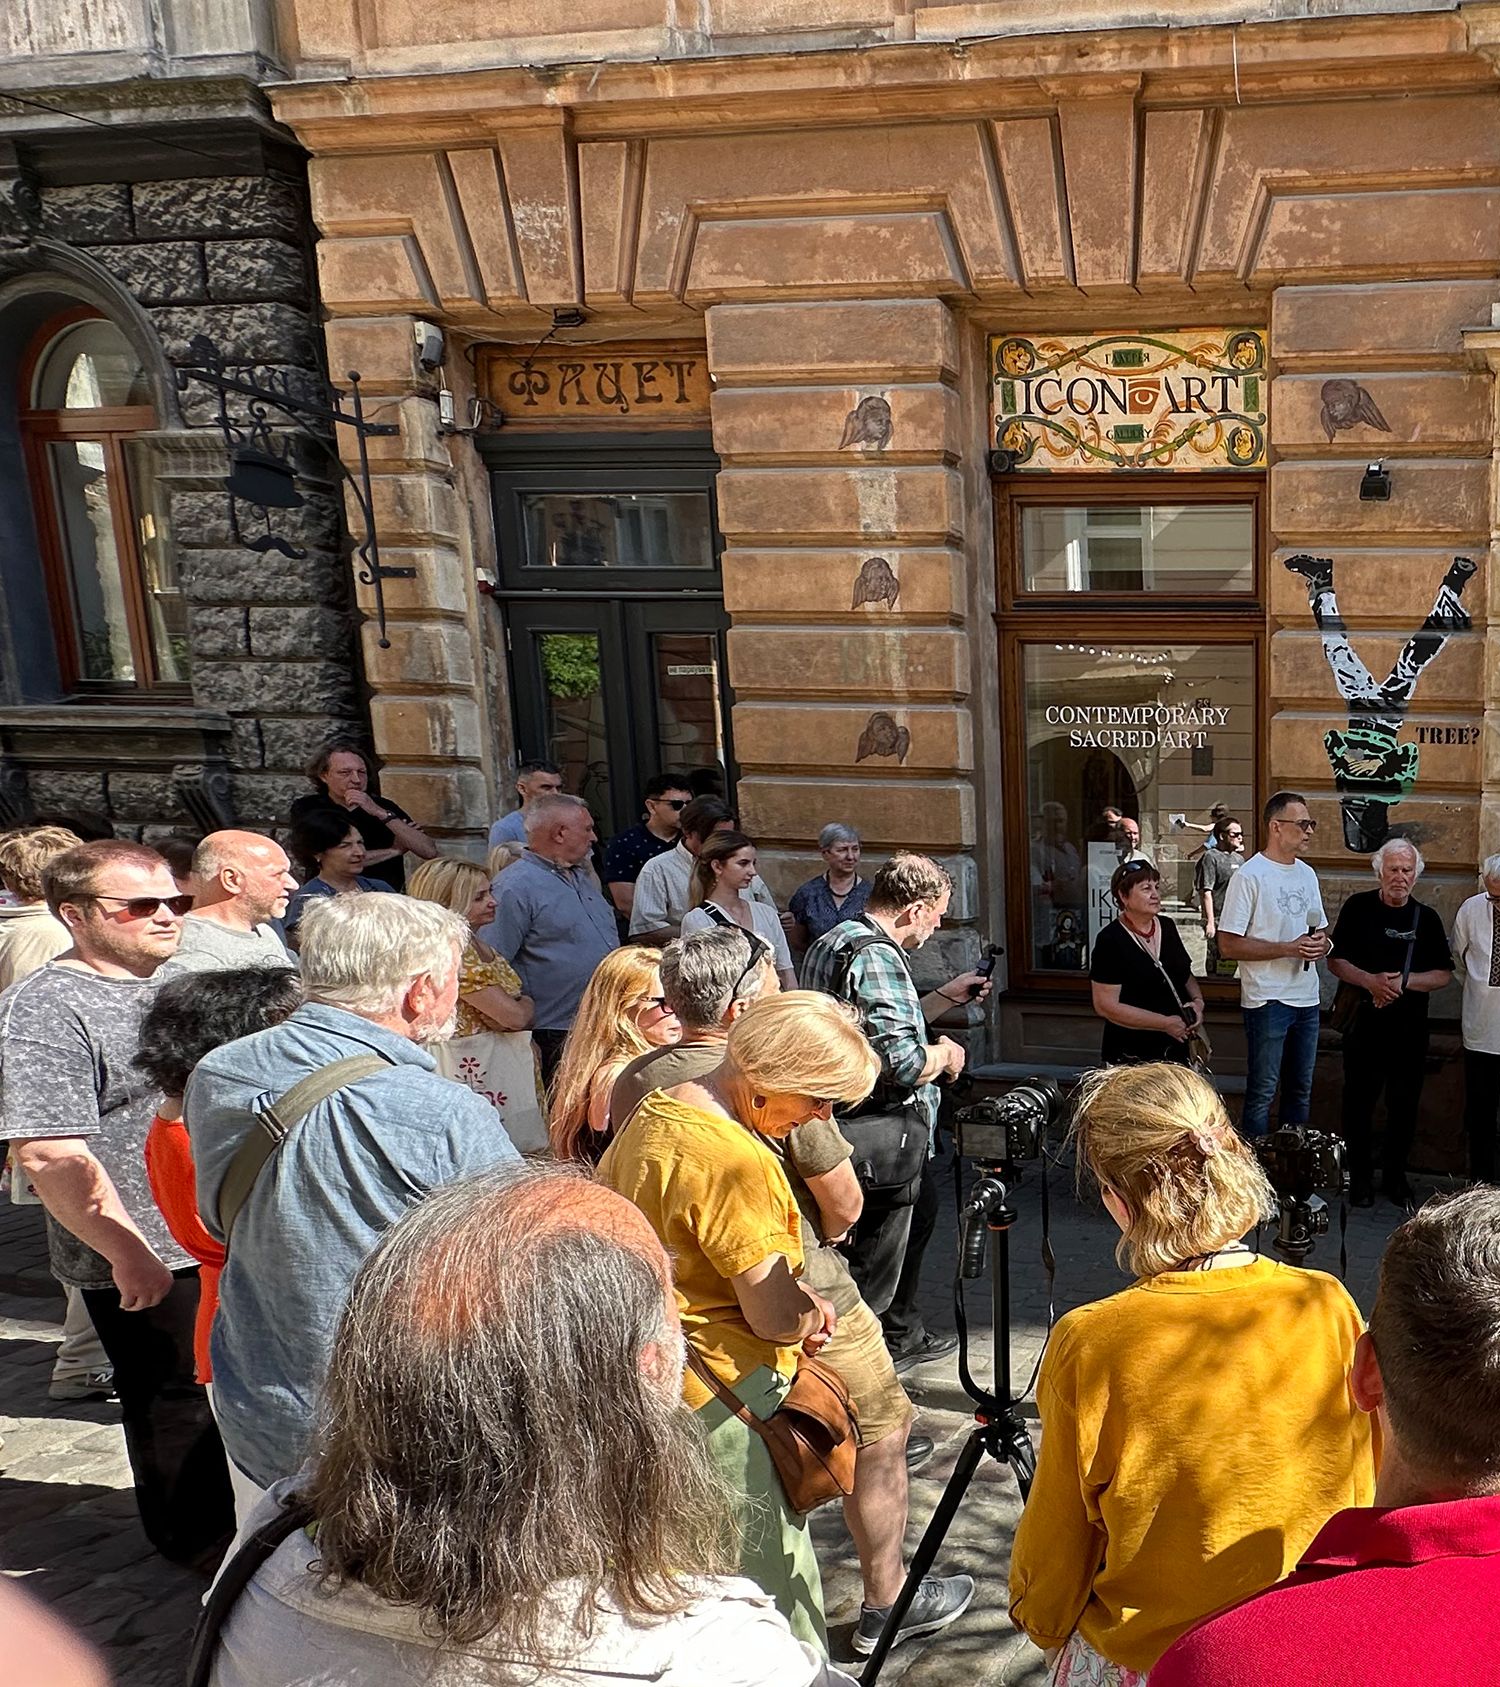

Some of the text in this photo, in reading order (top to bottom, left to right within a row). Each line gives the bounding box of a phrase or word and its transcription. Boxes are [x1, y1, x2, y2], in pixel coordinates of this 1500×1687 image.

[508, 360, 697, 413] ФАЦЕТ
[1021, 375, 1239, 415] ICON ART
[1045, 705, 1231, 726] CONTEMPORARY
[1070, 729, 1207, 749] SACRED ART
[1415, 726, 1480, 745] TREE?
